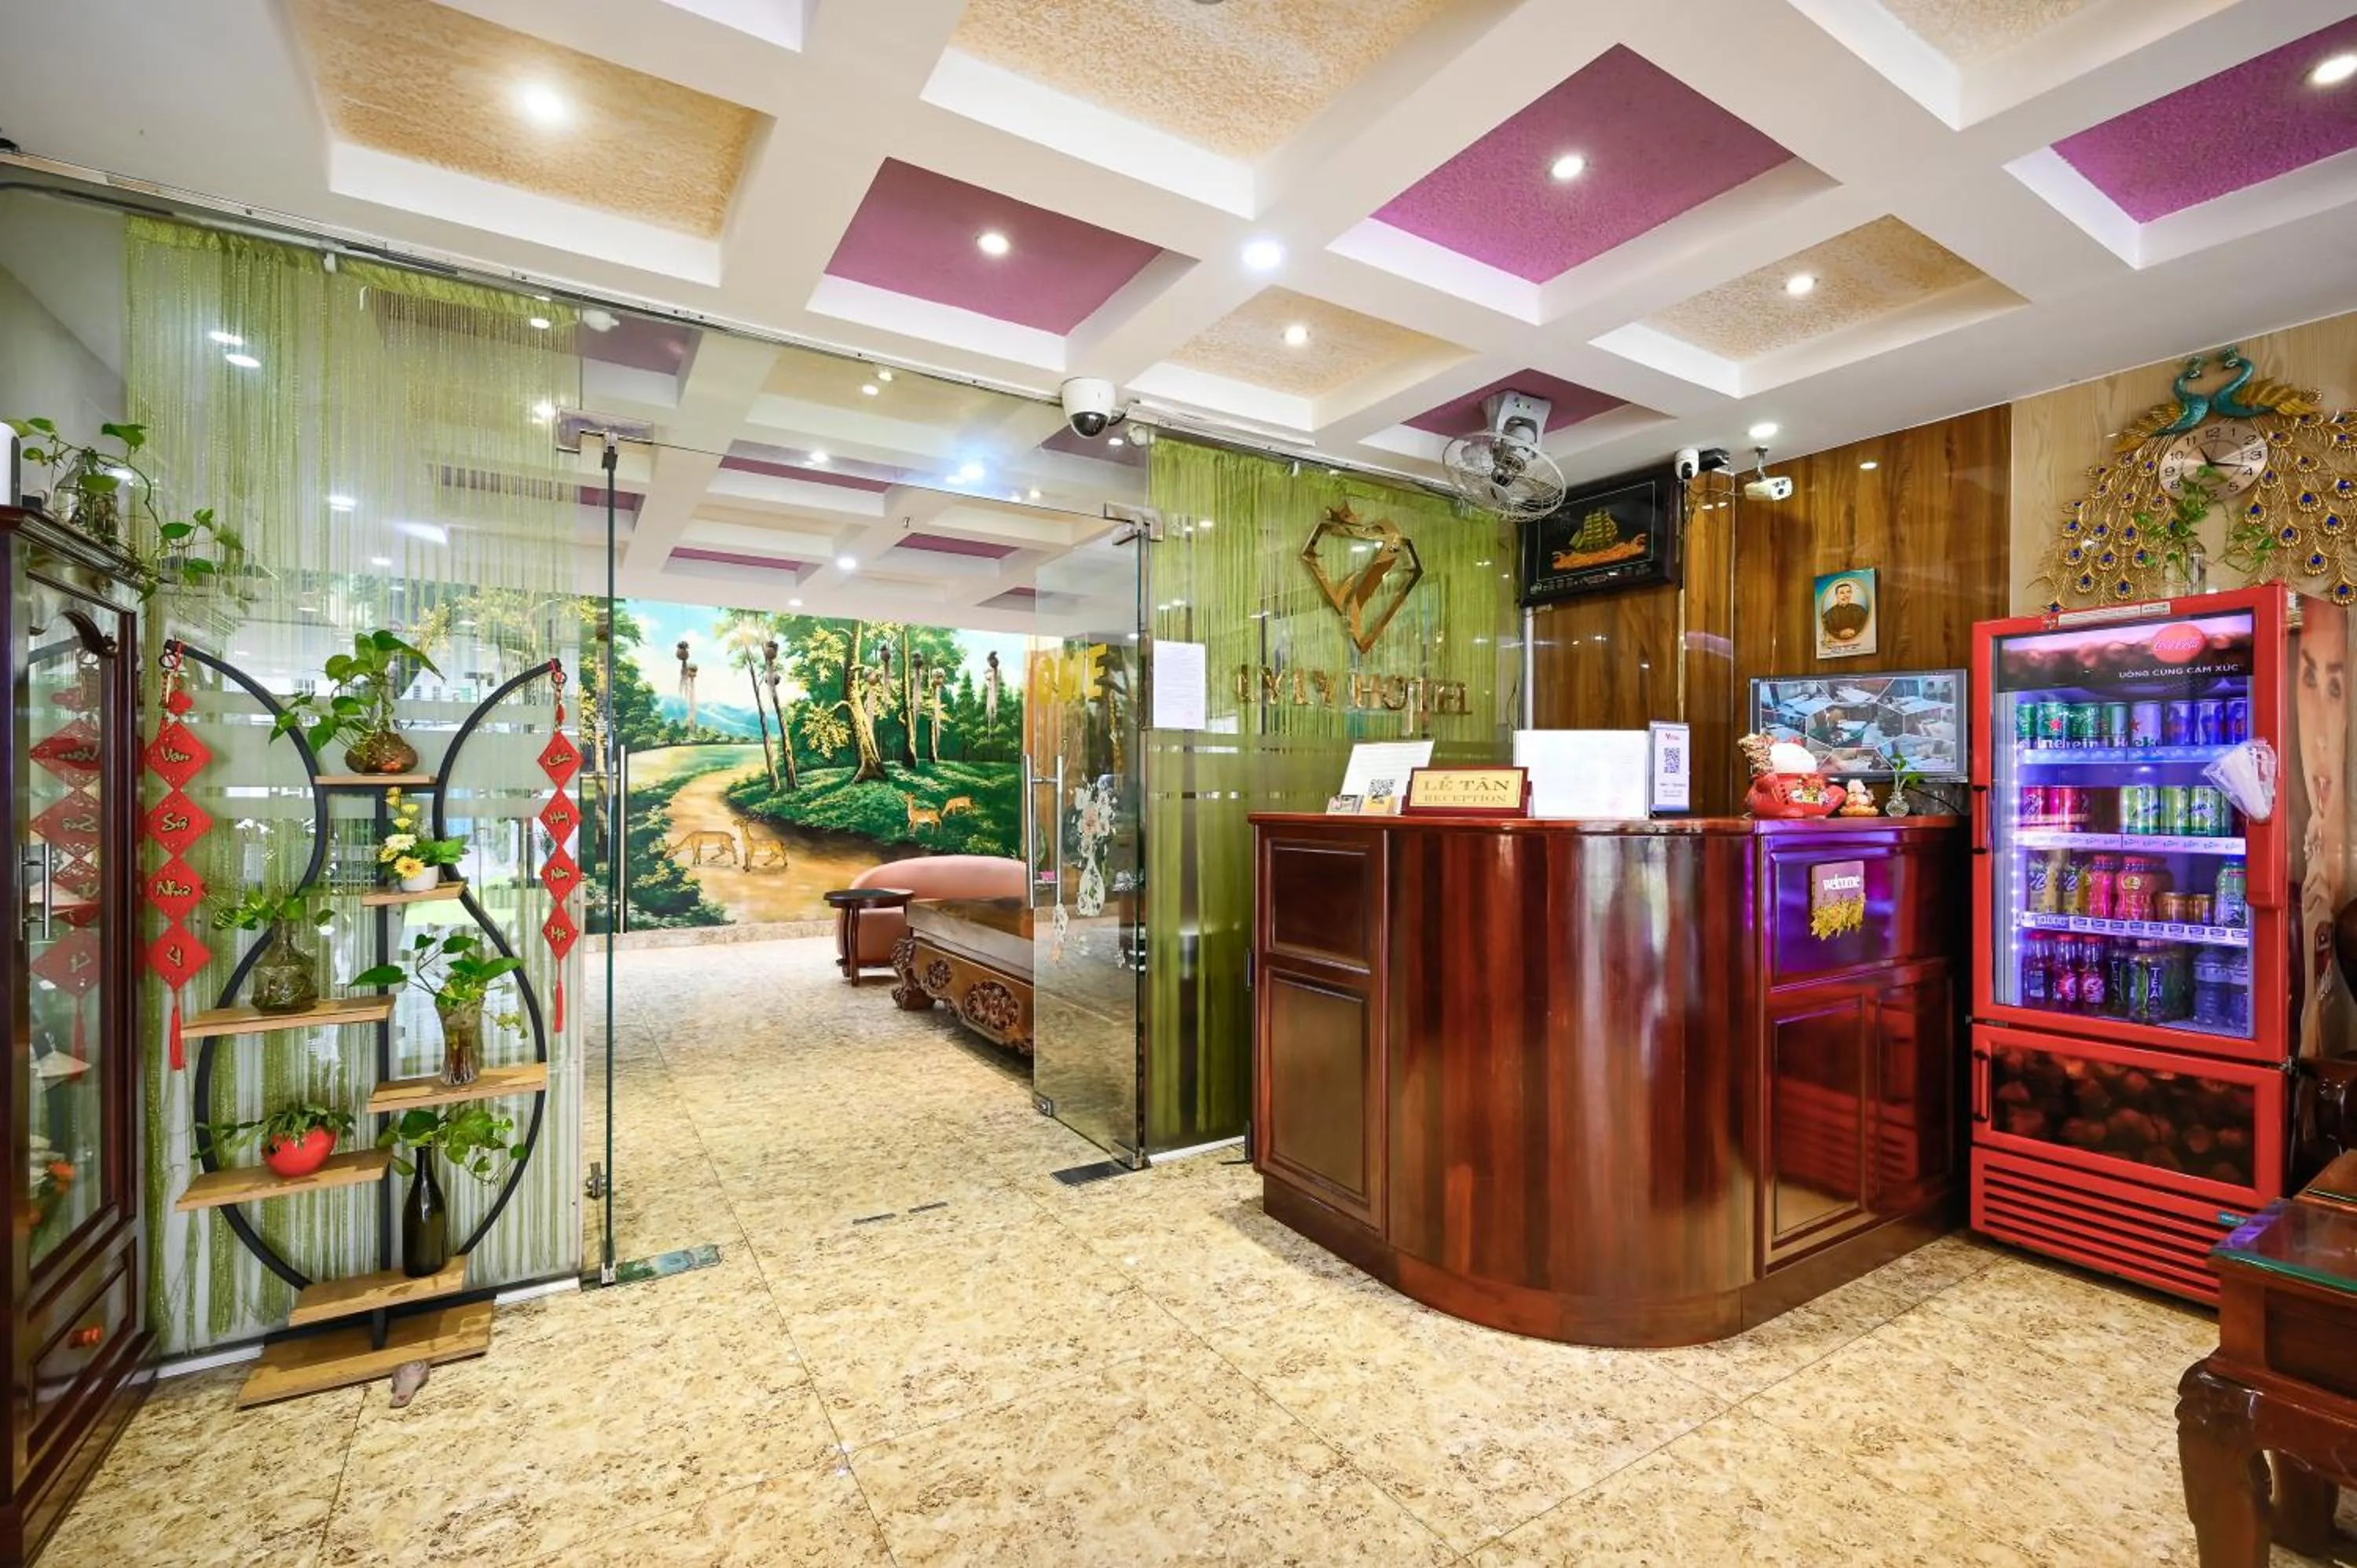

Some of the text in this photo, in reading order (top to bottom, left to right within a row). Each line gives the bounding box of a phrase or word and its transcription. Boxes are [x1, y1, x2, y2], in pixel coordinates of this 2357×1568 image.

[2205, 427, 2220, 438] 12
[2186, 436, 2197, 446] 11
[2245, 434, 2257, 445] 2
[2170, 451, 2184, 461] 10
[2249, 451, 2262, 460] 3
[2165, 467, 2176, 476] 9
[2243, 467, 2253, 476] 4
[2228, 482, 2238, 492] 5
[1424, 793, 1507, 802] RECEPTION
[2149, 967, 2161, 999] TEA
